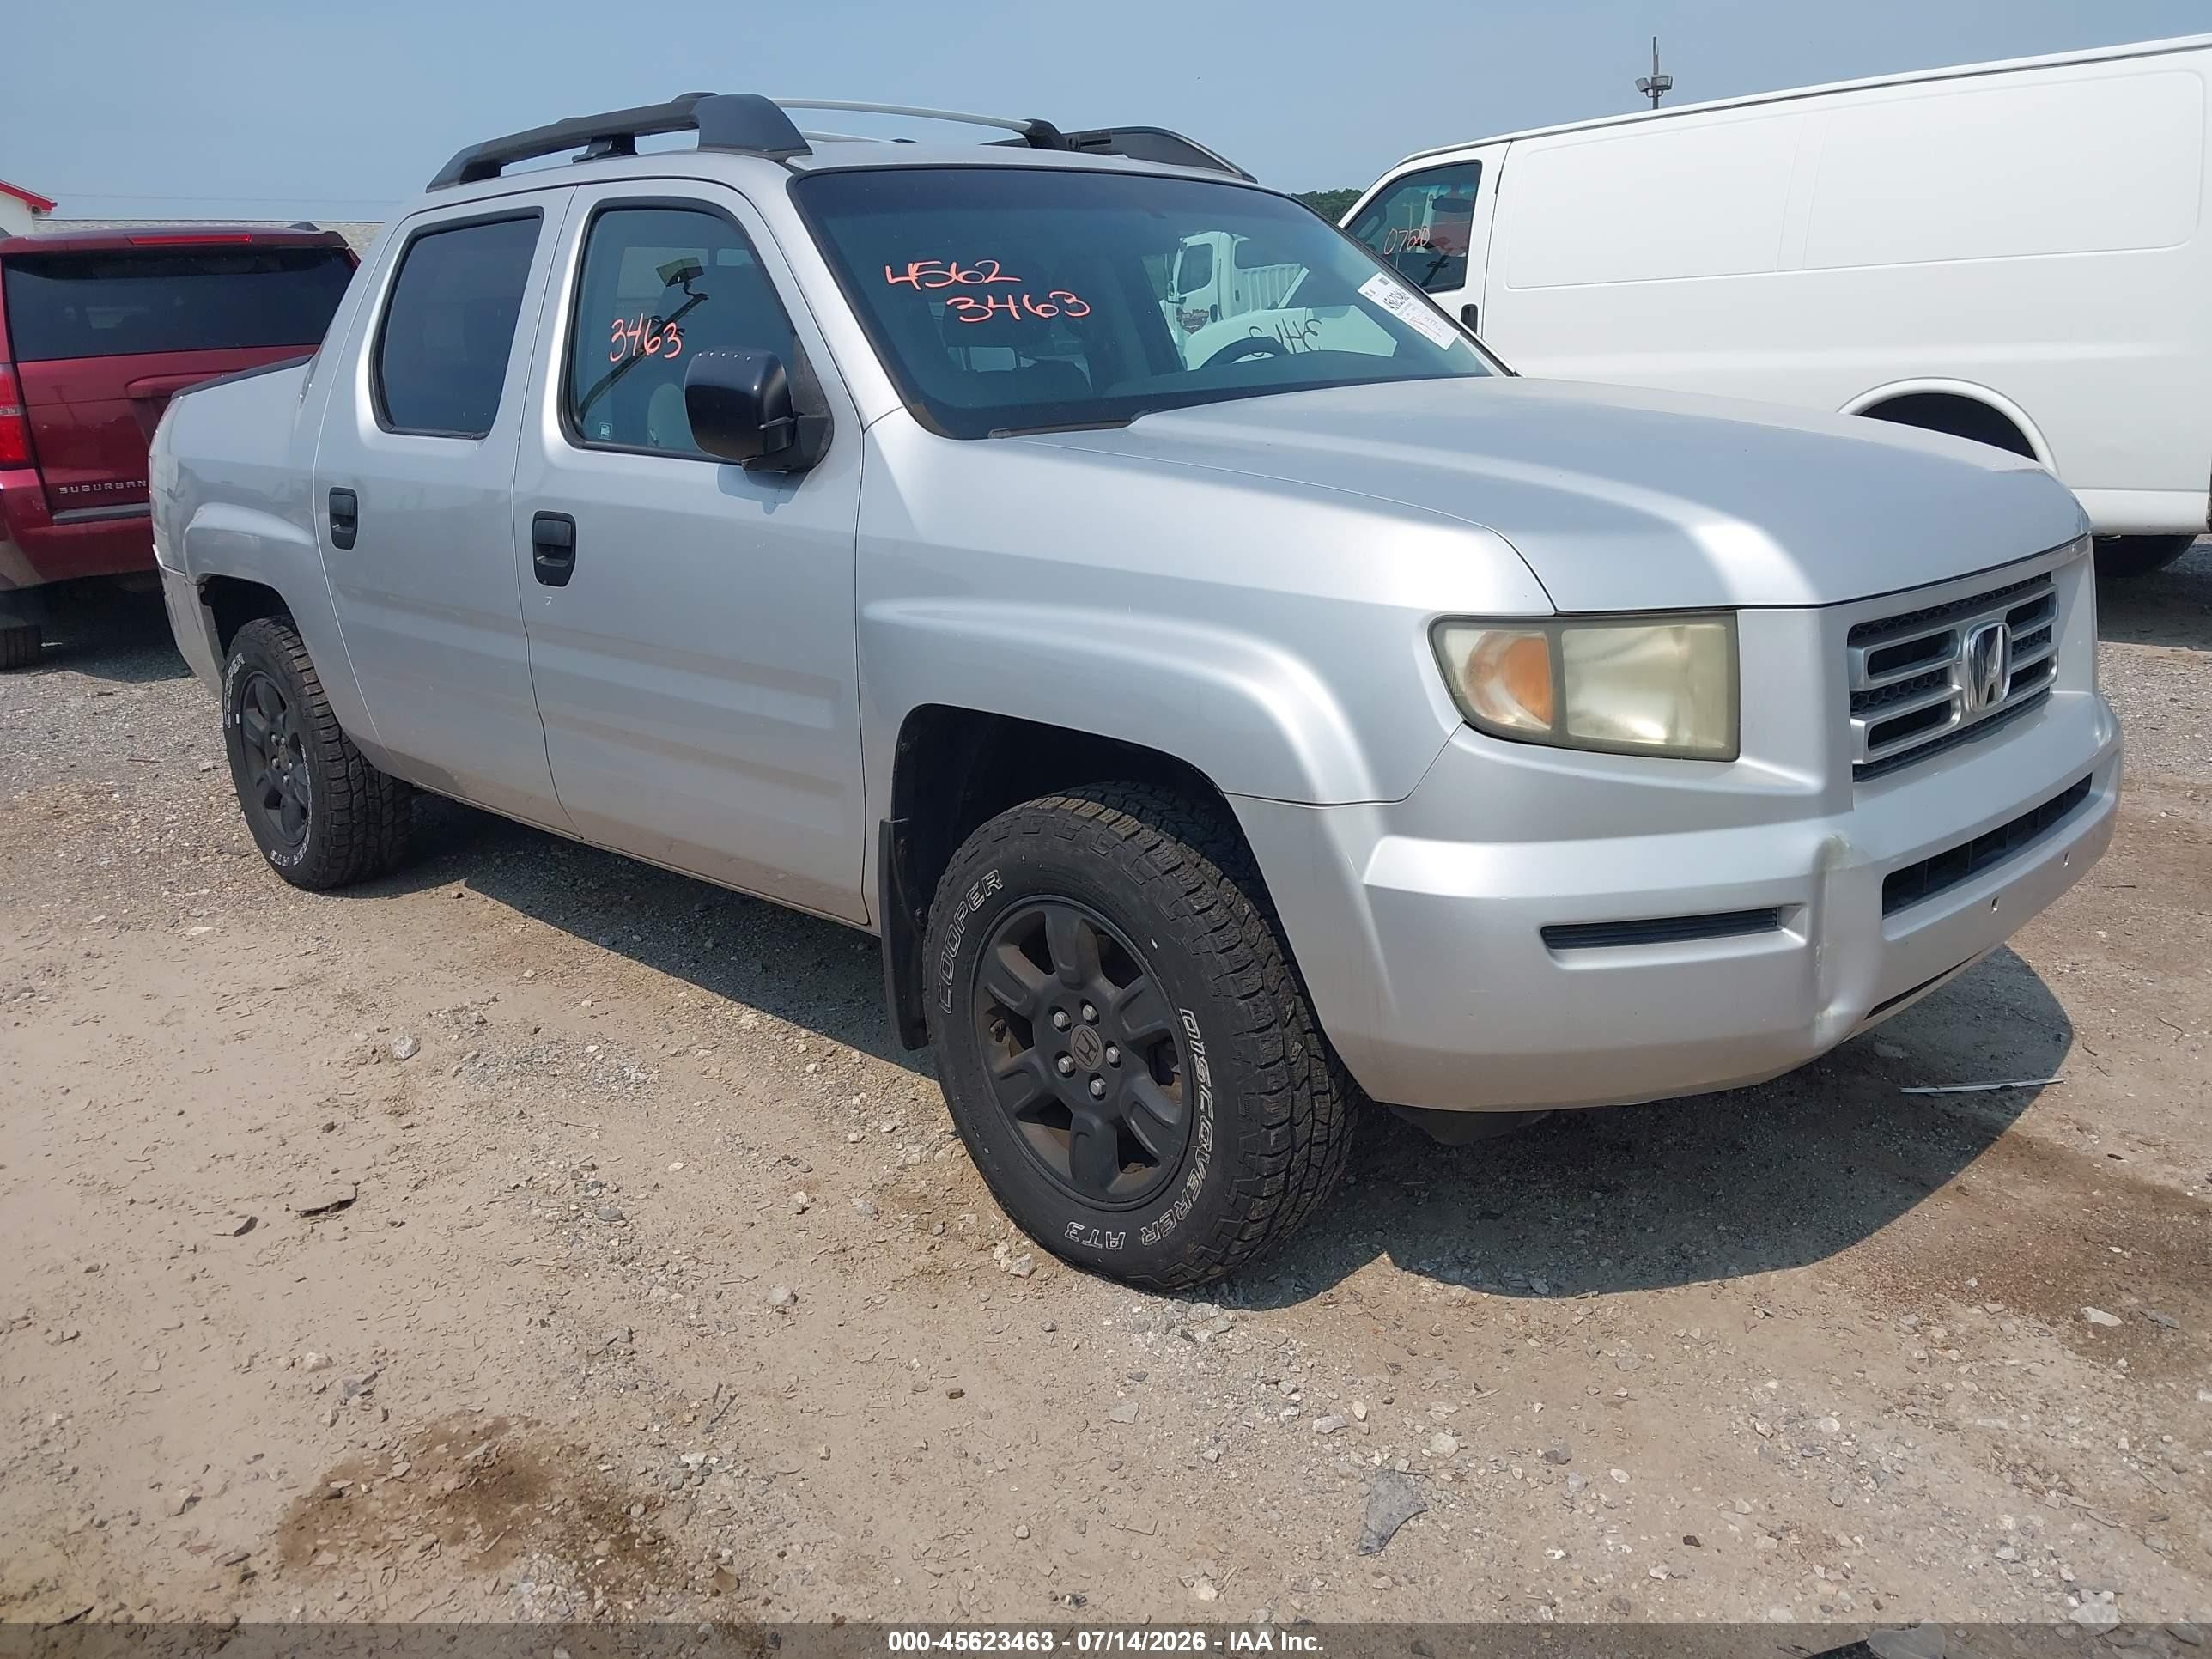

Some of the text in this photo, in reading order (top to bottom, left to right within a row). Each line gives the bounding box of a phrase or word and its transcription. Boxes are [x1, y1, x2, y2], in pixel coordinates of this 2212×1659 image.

[884, 259, 1023, 291] 4562
[946, 290, 1091, 323] 3463
[609, 312, 683, 362] 3463
[58, 480, 147, 494] SUBURBAN
[938, 869, 1004, 1014] COOPER
[1064, 1007, 1214, 1251] DISCOVERER AT3
